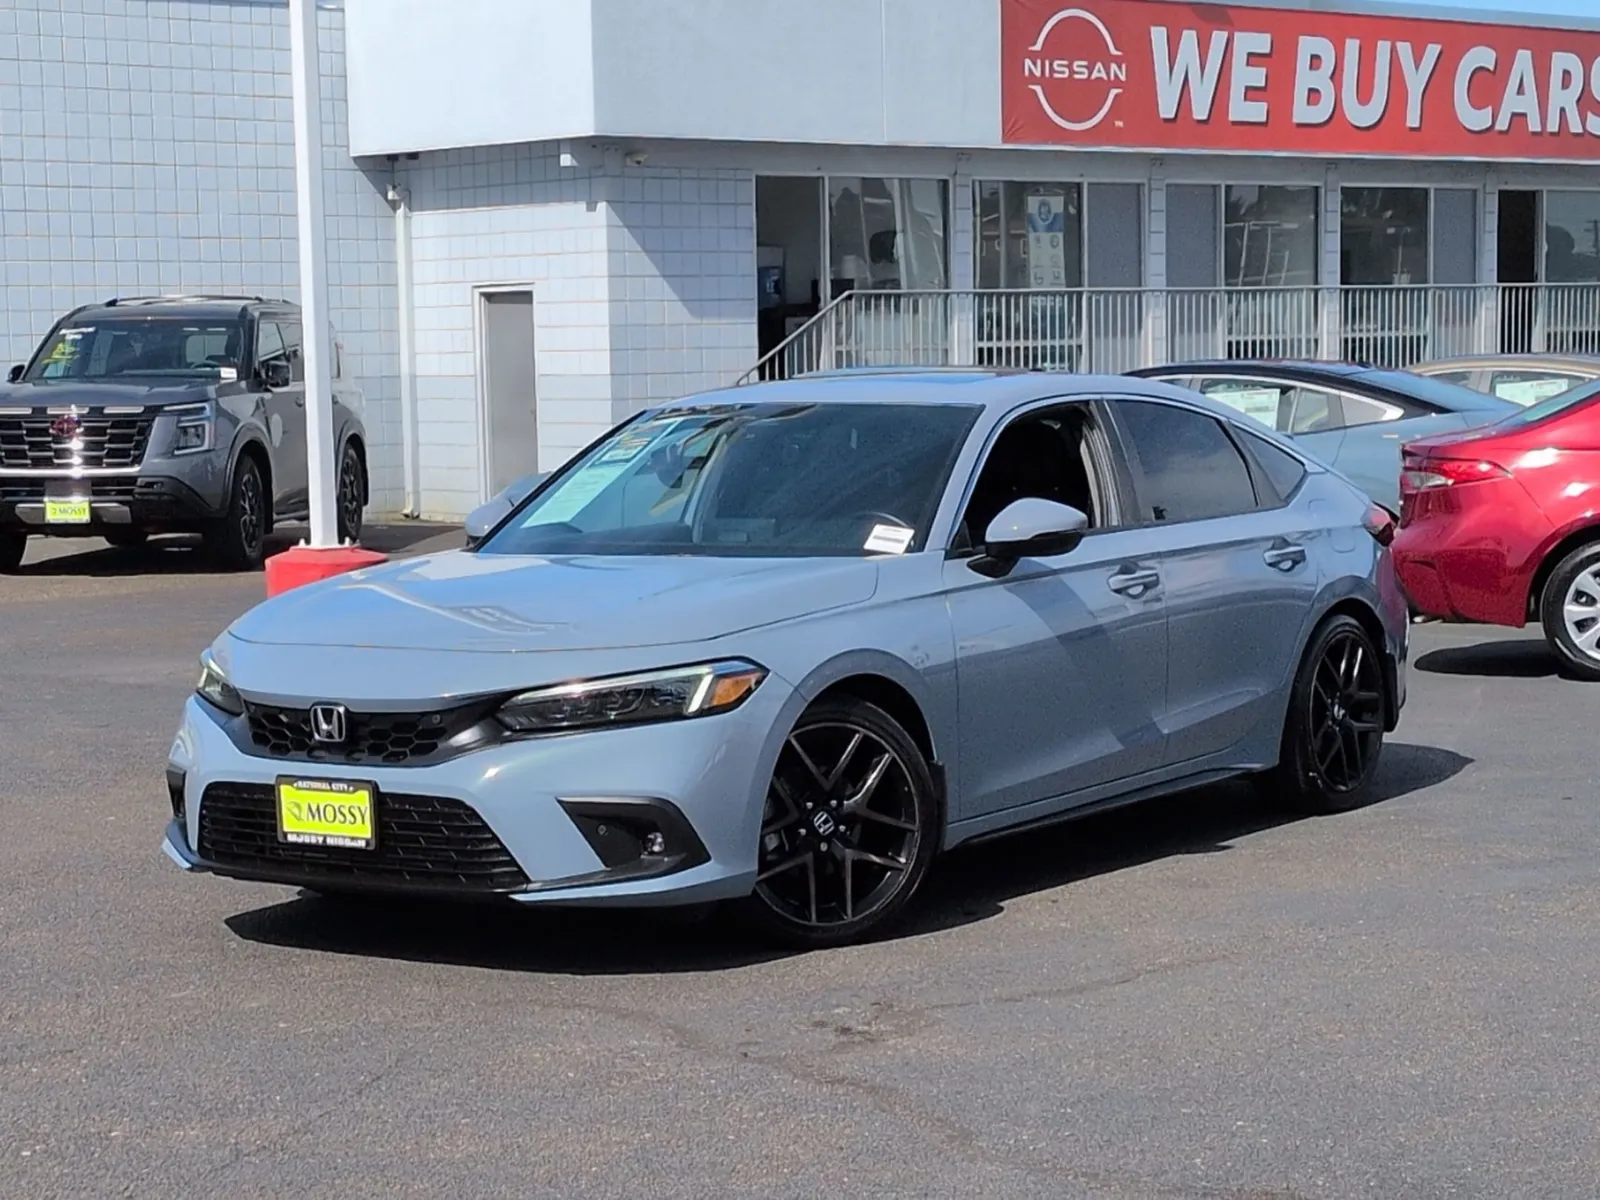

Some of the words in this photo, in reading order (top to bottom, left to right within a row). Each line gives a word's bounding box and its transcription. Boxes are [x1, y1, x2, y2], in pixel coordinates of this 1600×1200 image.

[1024, 58, 1126, 82] NISSAN
[1150, 26, 1272, 123] WE
[1292, 36, 1442, 128] BUY
[307, 802, 368, 825] MOSSY
